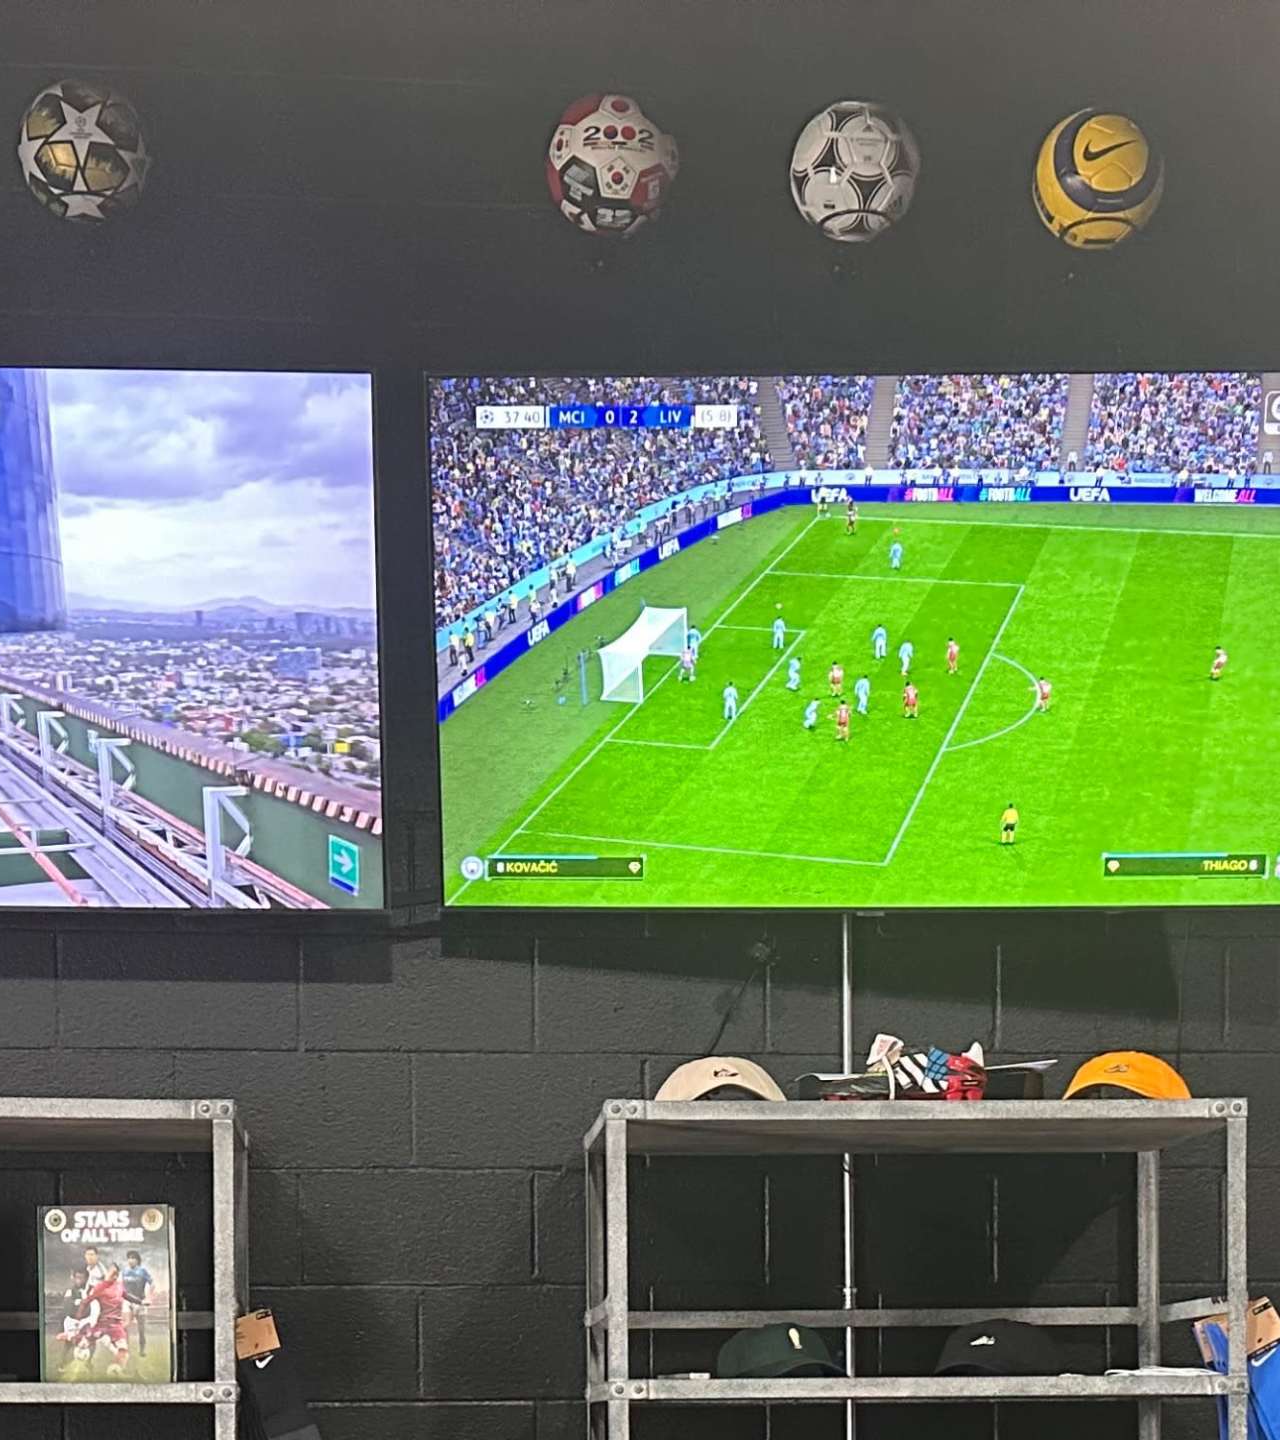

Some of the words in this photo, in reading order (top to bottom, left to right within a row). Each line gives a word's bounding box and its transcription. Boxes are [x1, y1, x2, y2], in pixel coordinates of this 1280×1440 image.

[559, 410, 585, 424] MCI
[605, 409, 615, 424] 0
[629, 410, 638, 424] 2
[659, 409, 682, 423] LIV
[1070, 487, 1111, 502] UEFA
[527, 619, 550, 646] UEFA
[1202, 860, 1248, 871] THIAGO
[74, 1210, 130, 1228] STARS
[61, 1228, 81, 1242] OF
[82, 1228, 109, 1242] ALL
[109, 1227, 145, 1242] TIME
